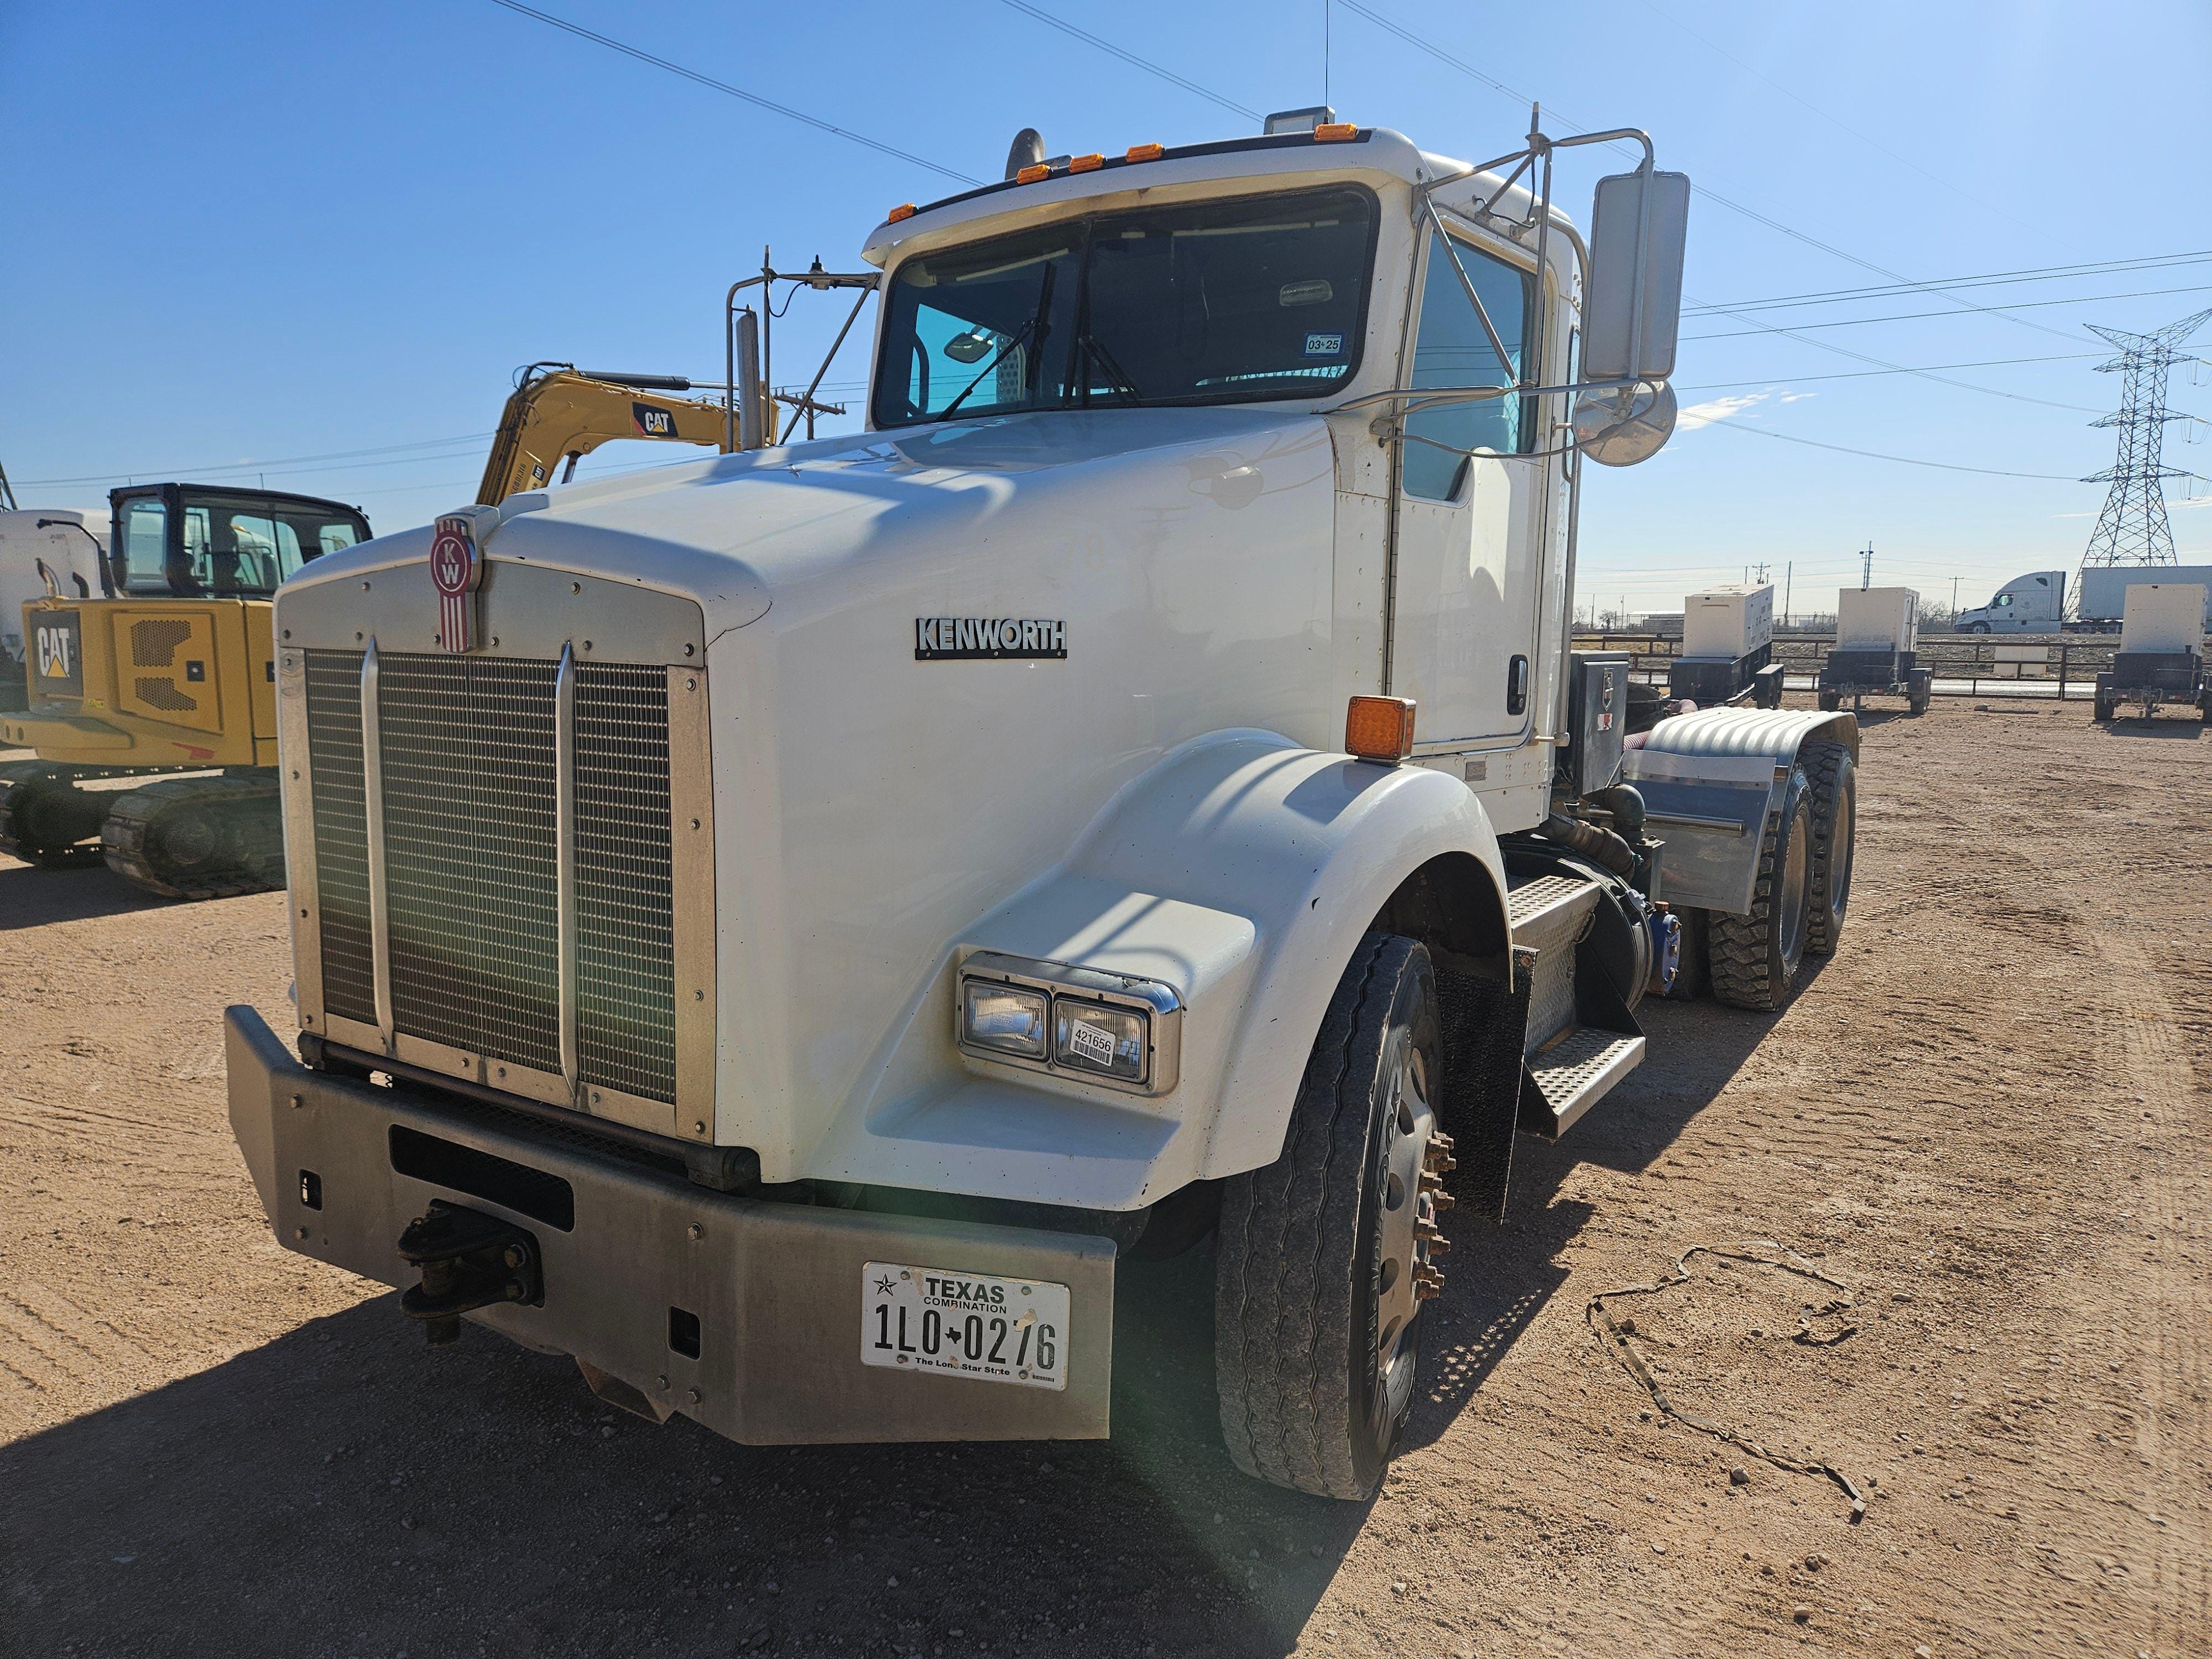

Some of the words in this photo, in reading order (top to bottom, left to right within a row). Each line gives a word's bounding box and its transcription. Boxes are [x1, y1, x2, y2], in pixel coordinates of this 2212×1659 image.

[1308, 340, 1321, 349] 03
[1326, 340, 1339, 349] 25
[645, 411, 669, 433] CAT
[916, 618, 1067, 650] KENWORTH
[38, 627, 70, 678] CAT
[1076, 1029, 1112, 1052] 421656
[925, 1277, 1005, 1305] TEXAS
[924, 1296, 1007, 1314] COMBINATION
[964, 1314, 1056, 1370] 0276
[915, 1357, 933, 1366] The
[961, 1363, 982, 1372] Star
